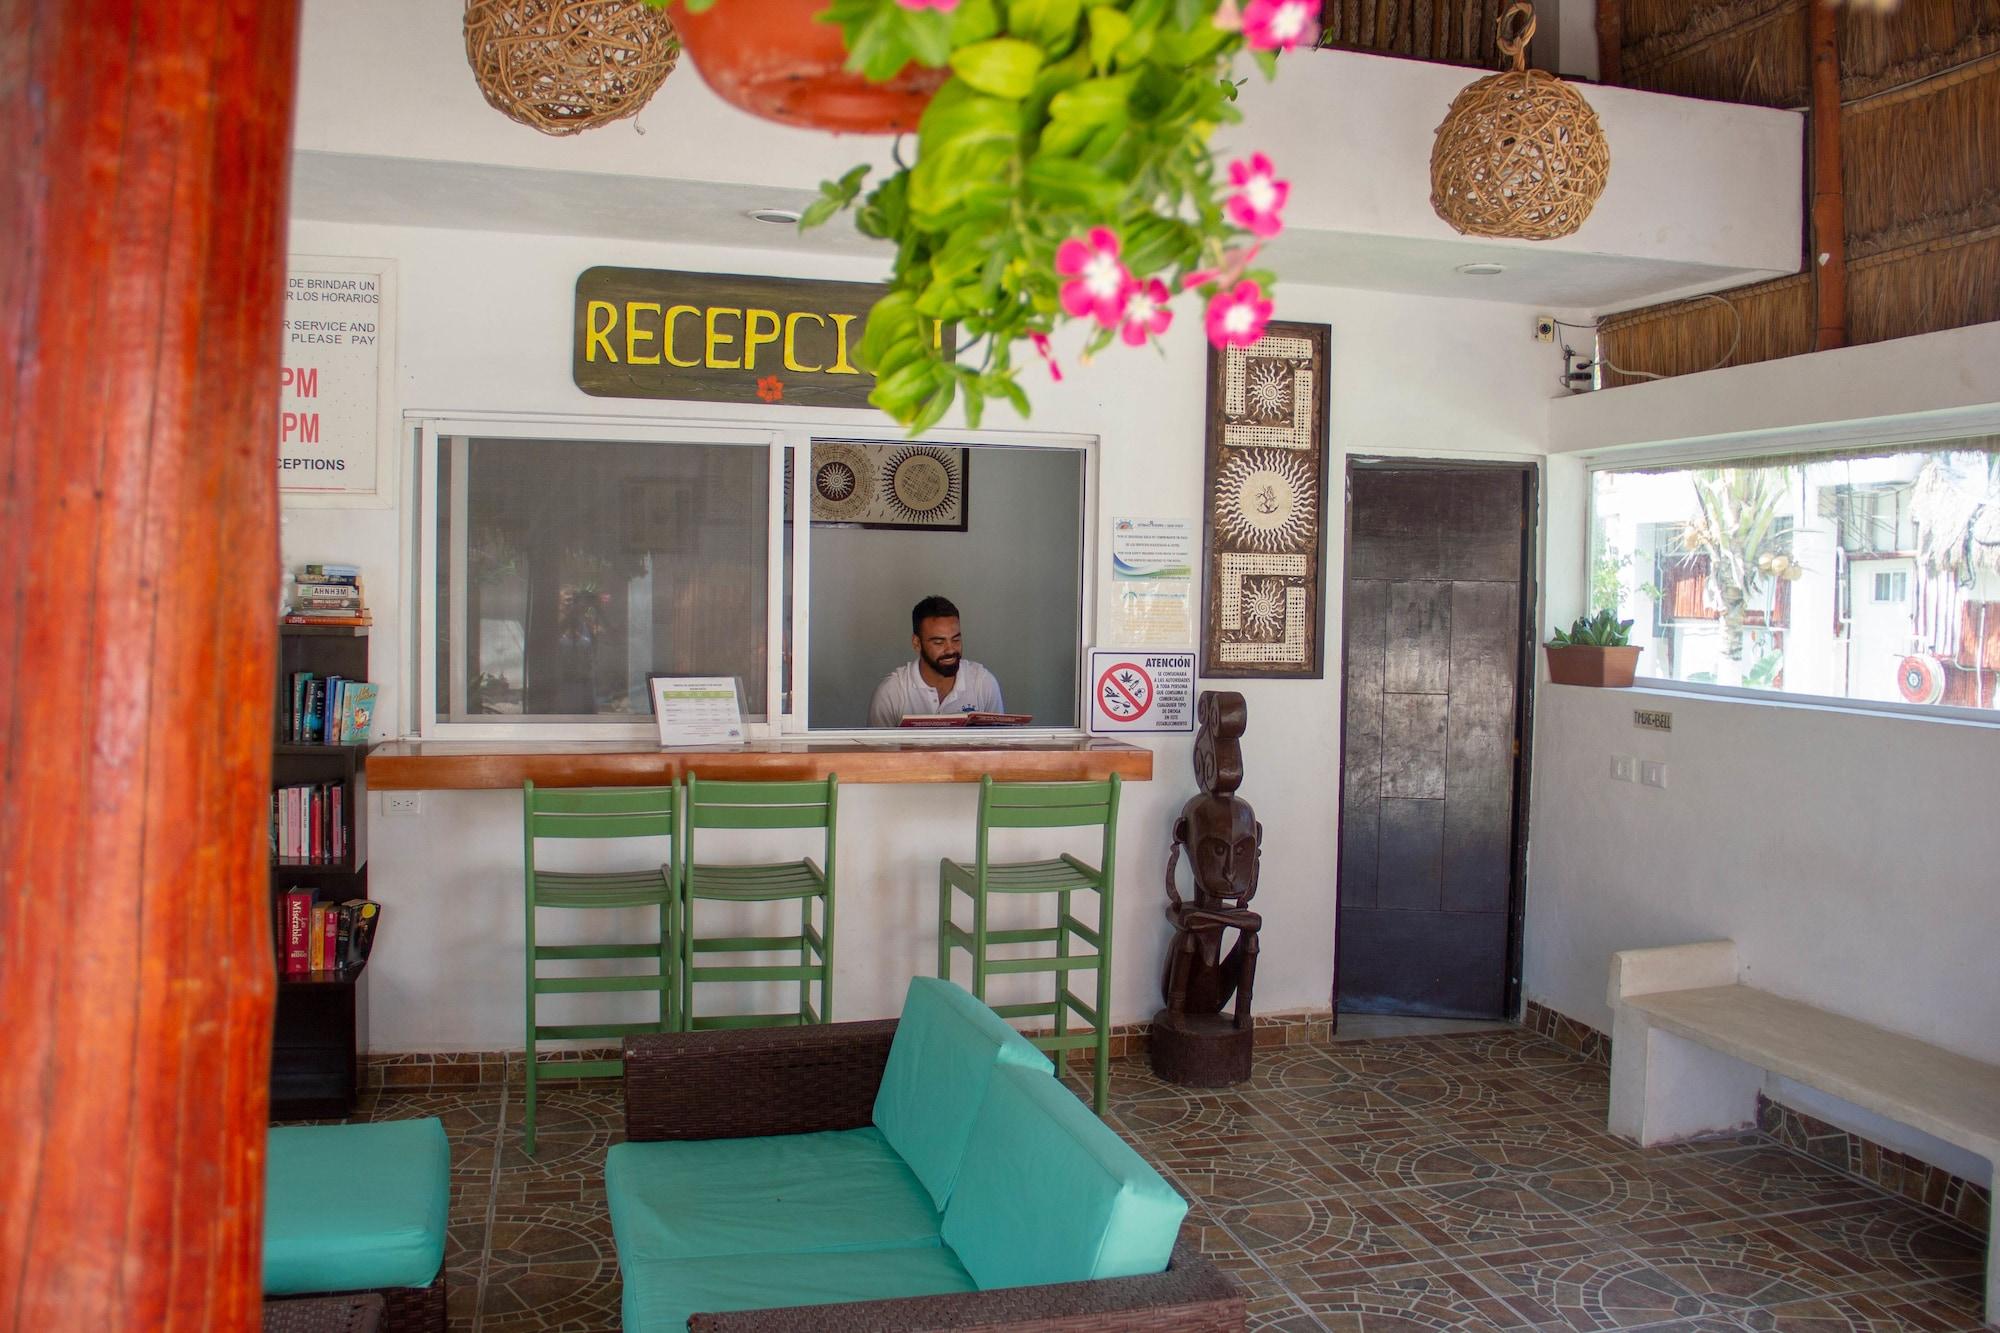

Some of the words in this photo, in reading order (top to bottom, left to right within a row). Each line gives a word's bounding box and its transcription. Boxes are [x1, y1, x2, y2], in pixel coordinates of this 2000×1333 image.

[289, 278, 304, 289] DE
[307, 279, 356, 291] BRINDAR
[360, 281, 375, 291] UN
[297, 291, 319, 302] LOS
[321, 292, 379, 304] HORARIOS
[294, 320, 347, 332] SERVICE
[350, 322, 375, 333] AND
[291, 334, 342, 345] PLEASE
[351, 335, 376, 345] PAY
[586, 301, 943, 376] RECEPCI
[280, 367, 318, 398] PM
[282, 412, 320, 443] PM
[276, 458, 345, 471] CEPTIONS
[1145, 656, 1190, 668] ATENCIÓN
